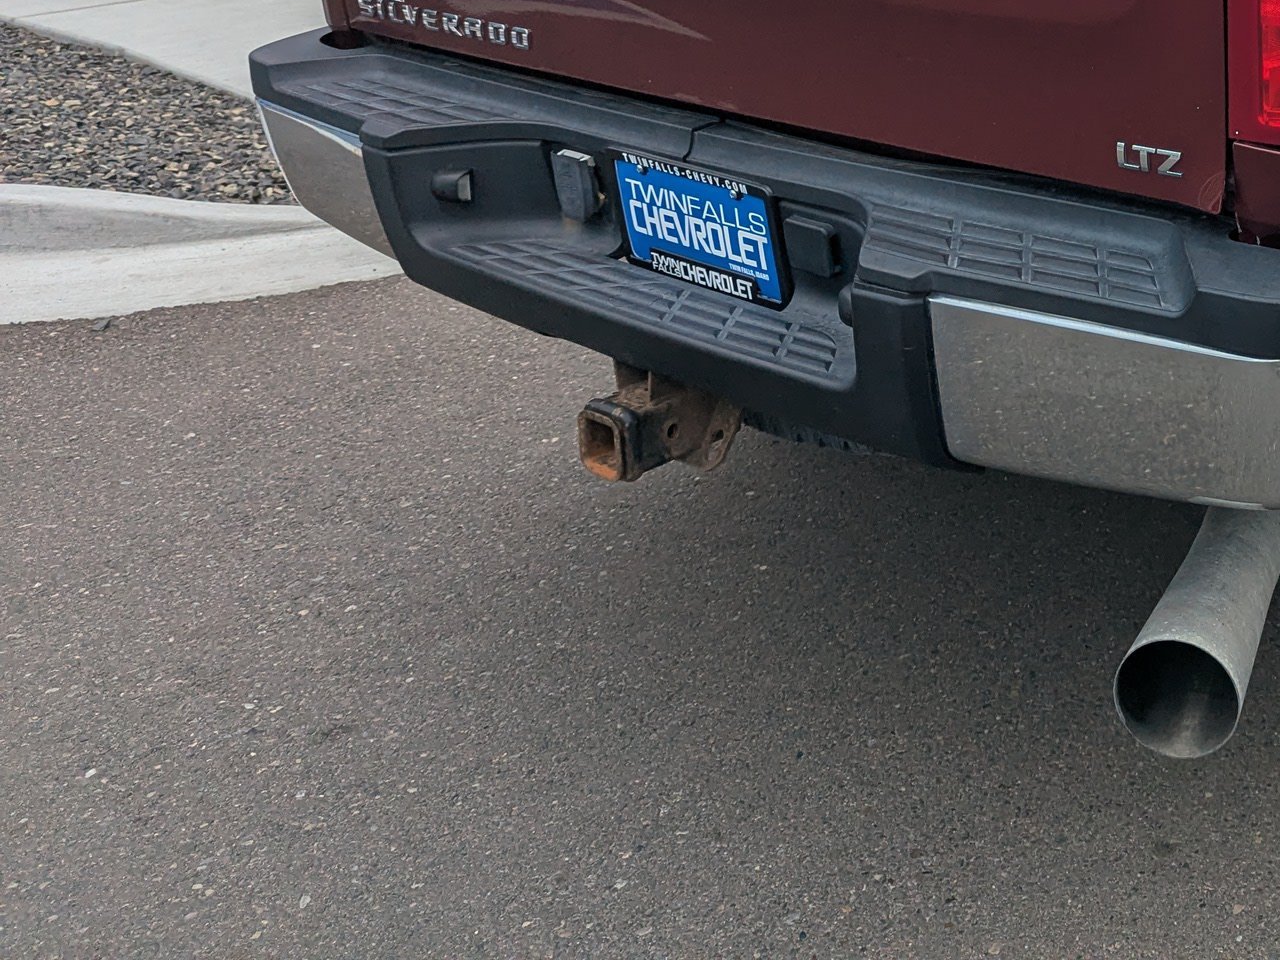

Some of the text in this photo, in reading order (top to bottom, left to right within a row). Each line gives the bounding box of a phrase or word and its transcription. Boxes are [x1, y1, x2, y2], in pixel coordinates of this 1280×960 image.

[621, 151, 749, 195] TWINFALLS-CHEVY.COM
[1116, 141, 1184, 178] LTZ
[624, 177, 767, 236] TWINFALLS
[628, 199, 768, 271] CHEVROLET
[650, 251, 680, 269] TWIN
[652, 262, 682, 278] FALLS
[680, 261, 753, 300] CHEVROLET
